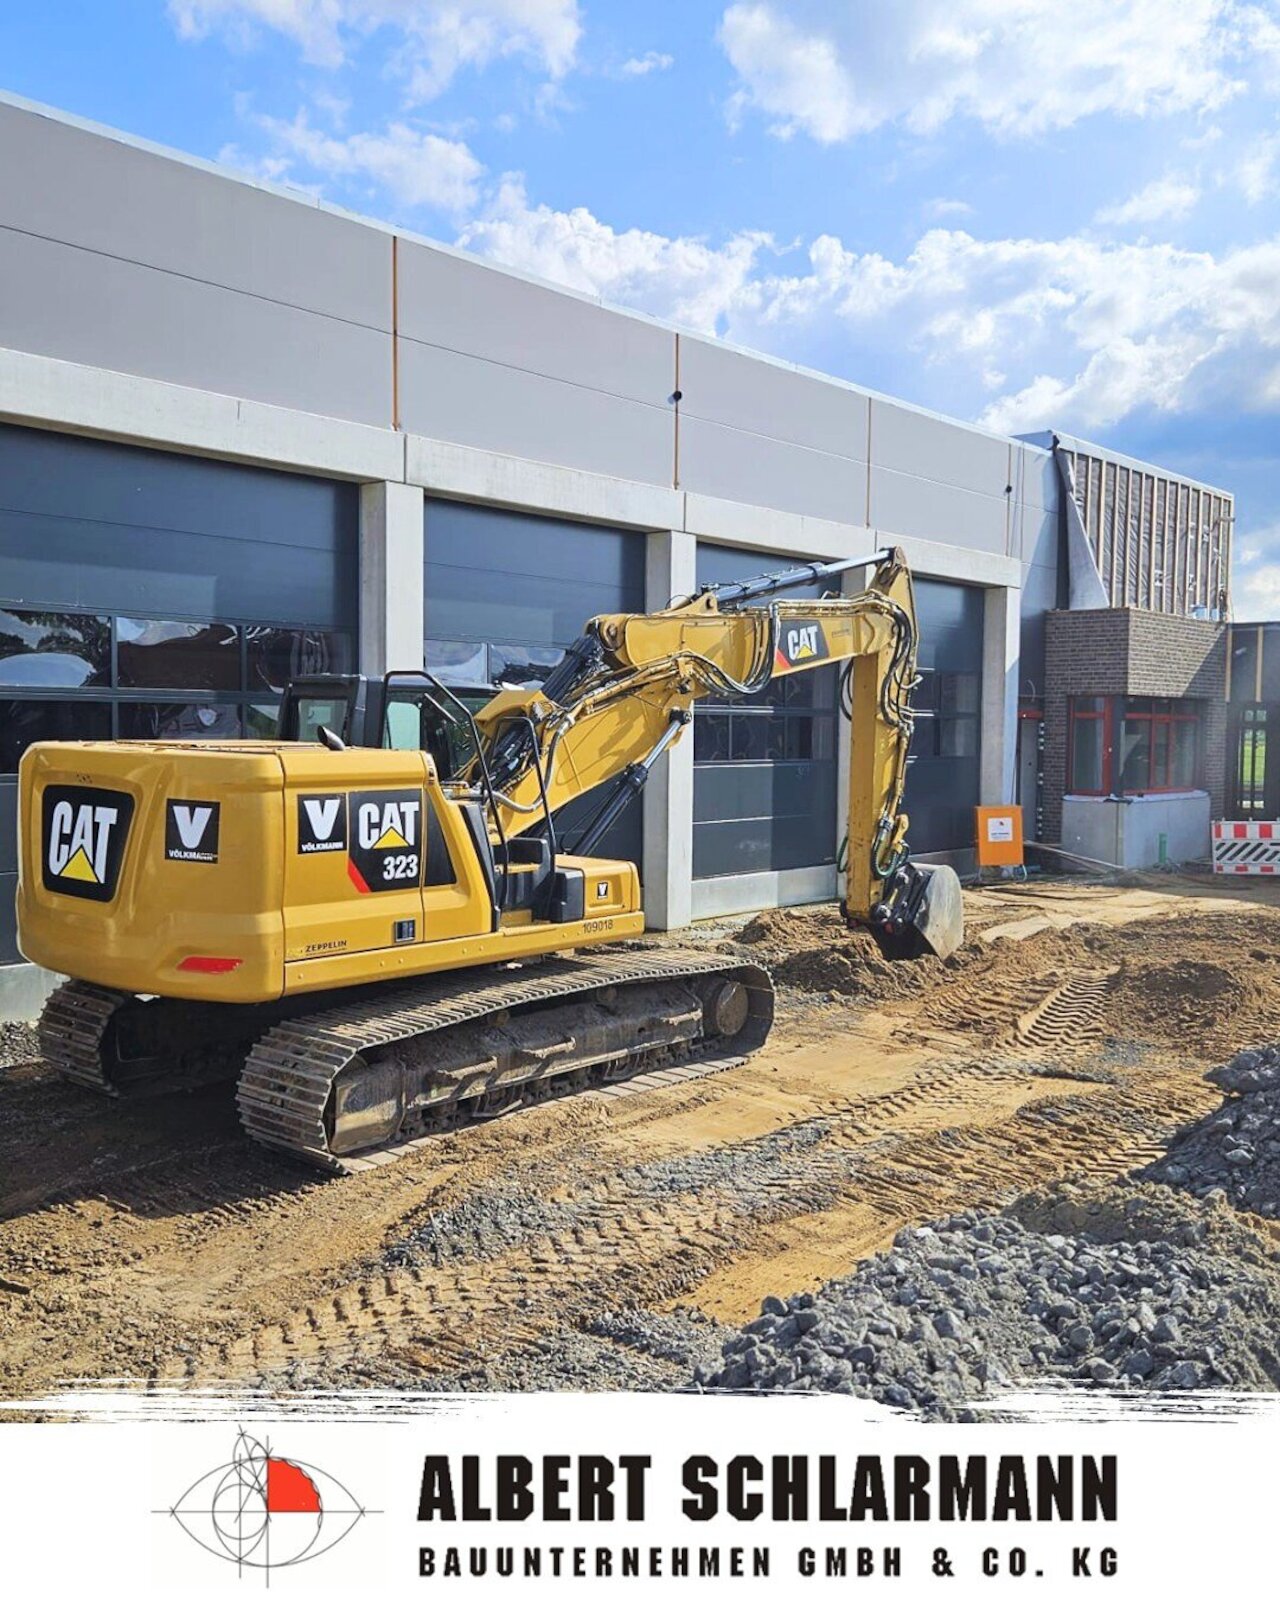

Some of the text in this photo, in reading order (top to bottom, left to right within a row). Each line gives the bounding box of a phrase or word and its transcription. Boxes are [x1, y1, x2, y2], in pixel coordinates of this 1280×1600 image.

[788, 625, 818, 660] CAT
[173, 805, 213, 849] V
[303, 799, 341, 840] V
[358, 801, 420, 850] CAT
[49, 801, 118, 884] CAT
[301, 841, 344, 852] VÖLKMANN
[382, 854, 418, 880] 323
[583, 919, 614, 934] 109018
[305, 940, 347, 953] ZEPPELIN
